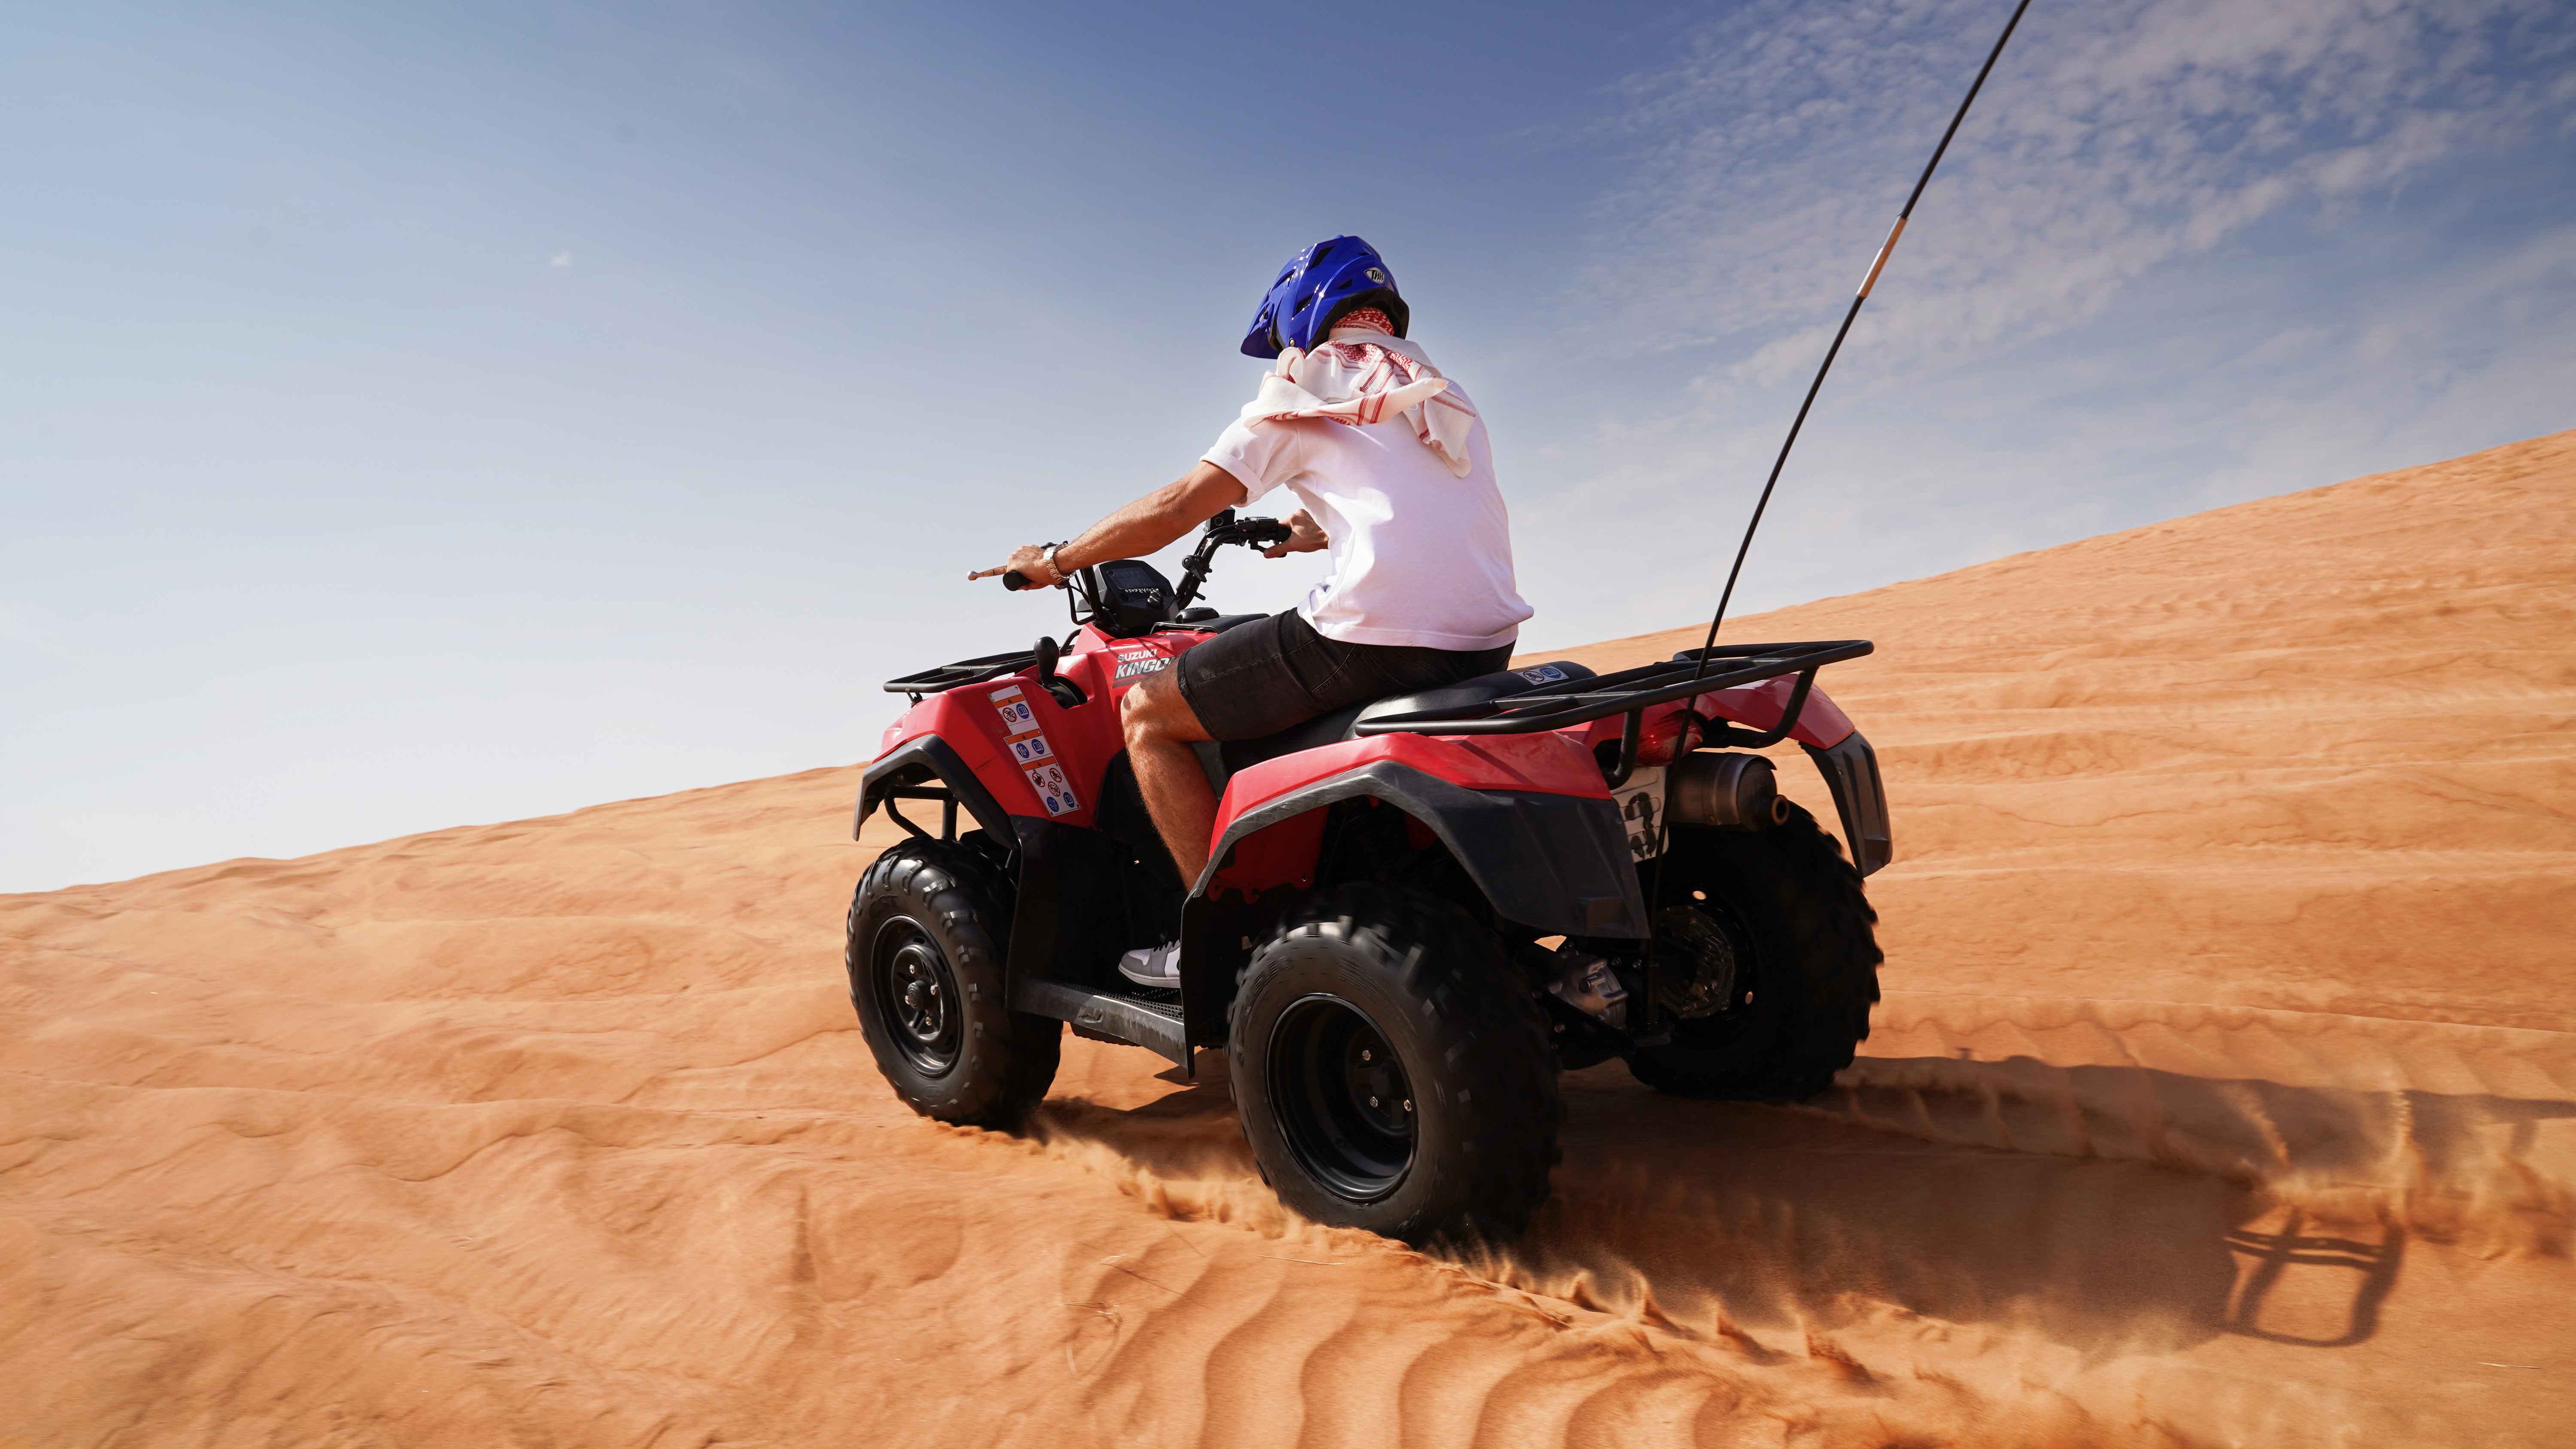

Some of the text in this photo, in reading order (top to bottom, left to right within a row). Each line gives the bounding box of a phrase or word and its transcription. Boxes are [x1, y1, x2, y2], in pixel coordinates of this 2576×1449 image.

[1365, 269, 1384, 281] THH
[1118, 649, 1157, 663] SUZUKI
[1017, 746, 1027, 756] 16+
